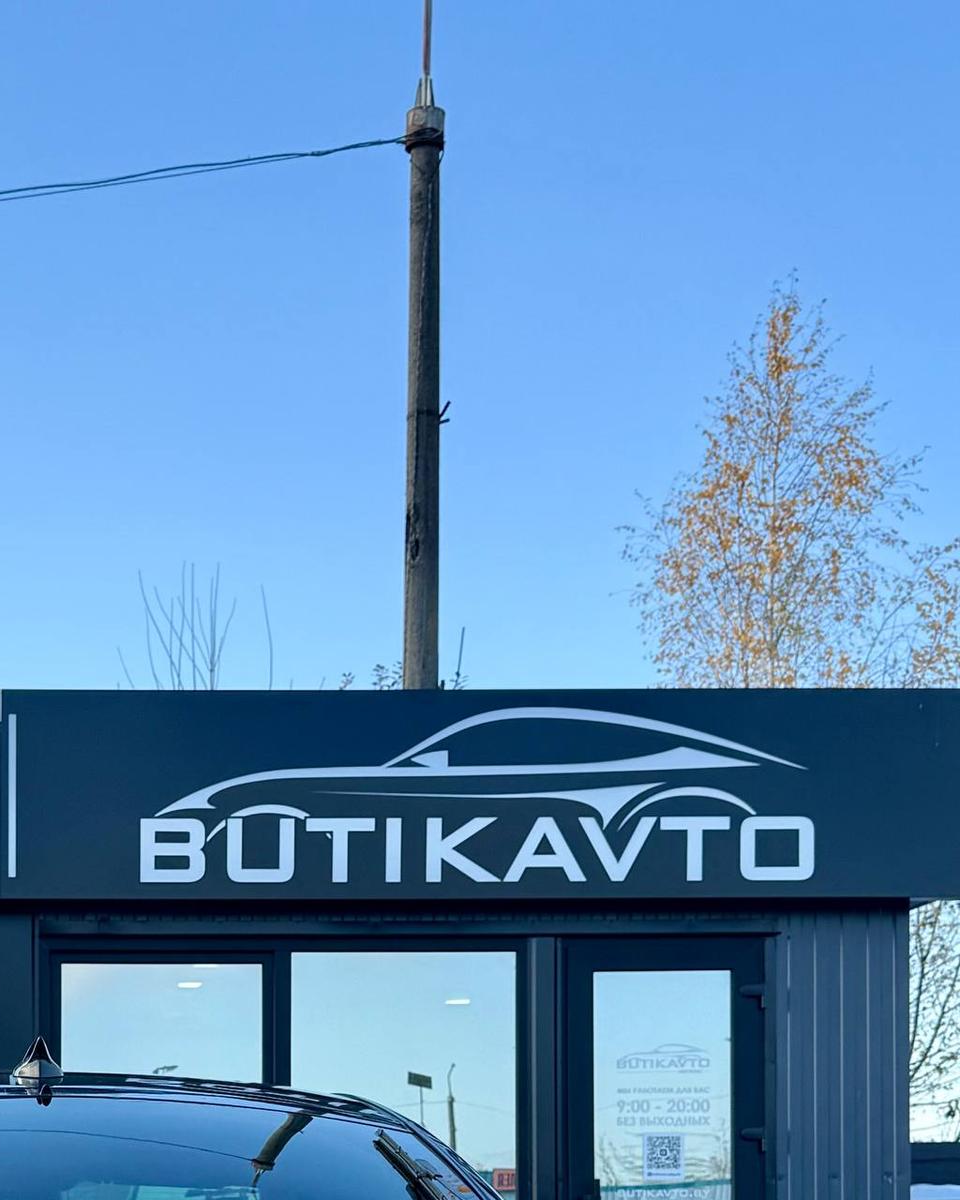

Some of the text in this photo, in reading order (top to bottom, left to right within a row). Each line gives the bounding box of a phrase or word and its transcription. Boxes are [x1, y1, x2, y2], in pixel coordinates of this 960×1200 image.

[139, 815, 815, 884] BUTIKAVTO
[616, 1099, 651, 1113] 9:00
[666, 1099, 711, 1113] 20:00
[616, 1116, 636, 1127] БЕЗ
